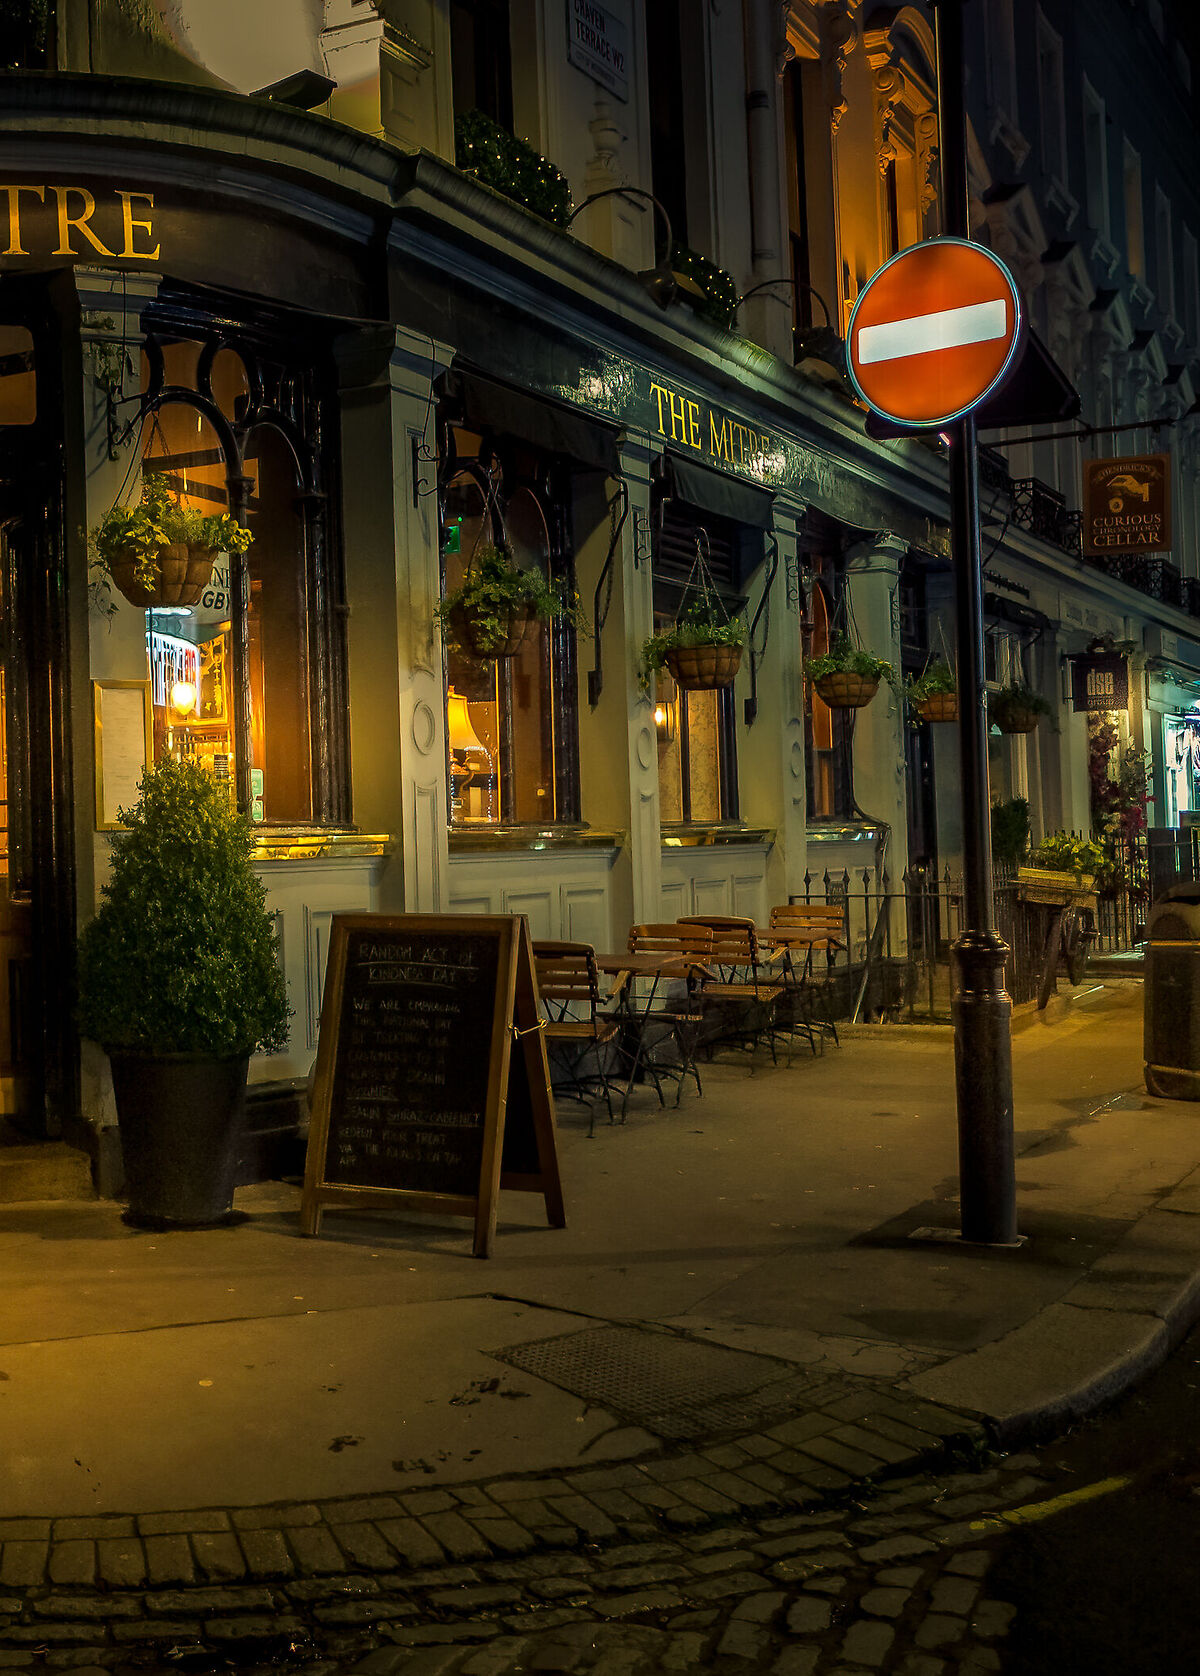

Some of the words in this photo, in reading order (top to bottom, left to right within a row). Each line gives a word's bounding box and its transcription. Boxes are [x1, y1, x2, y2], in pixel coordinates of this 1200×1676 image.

[575, 18, 611, 62] TERRACE
[649, 381, 702, 450] THE
[1093, 513, 1161, 528] CURIOUS
[1093, 532, 1161, 547] CELLAR
